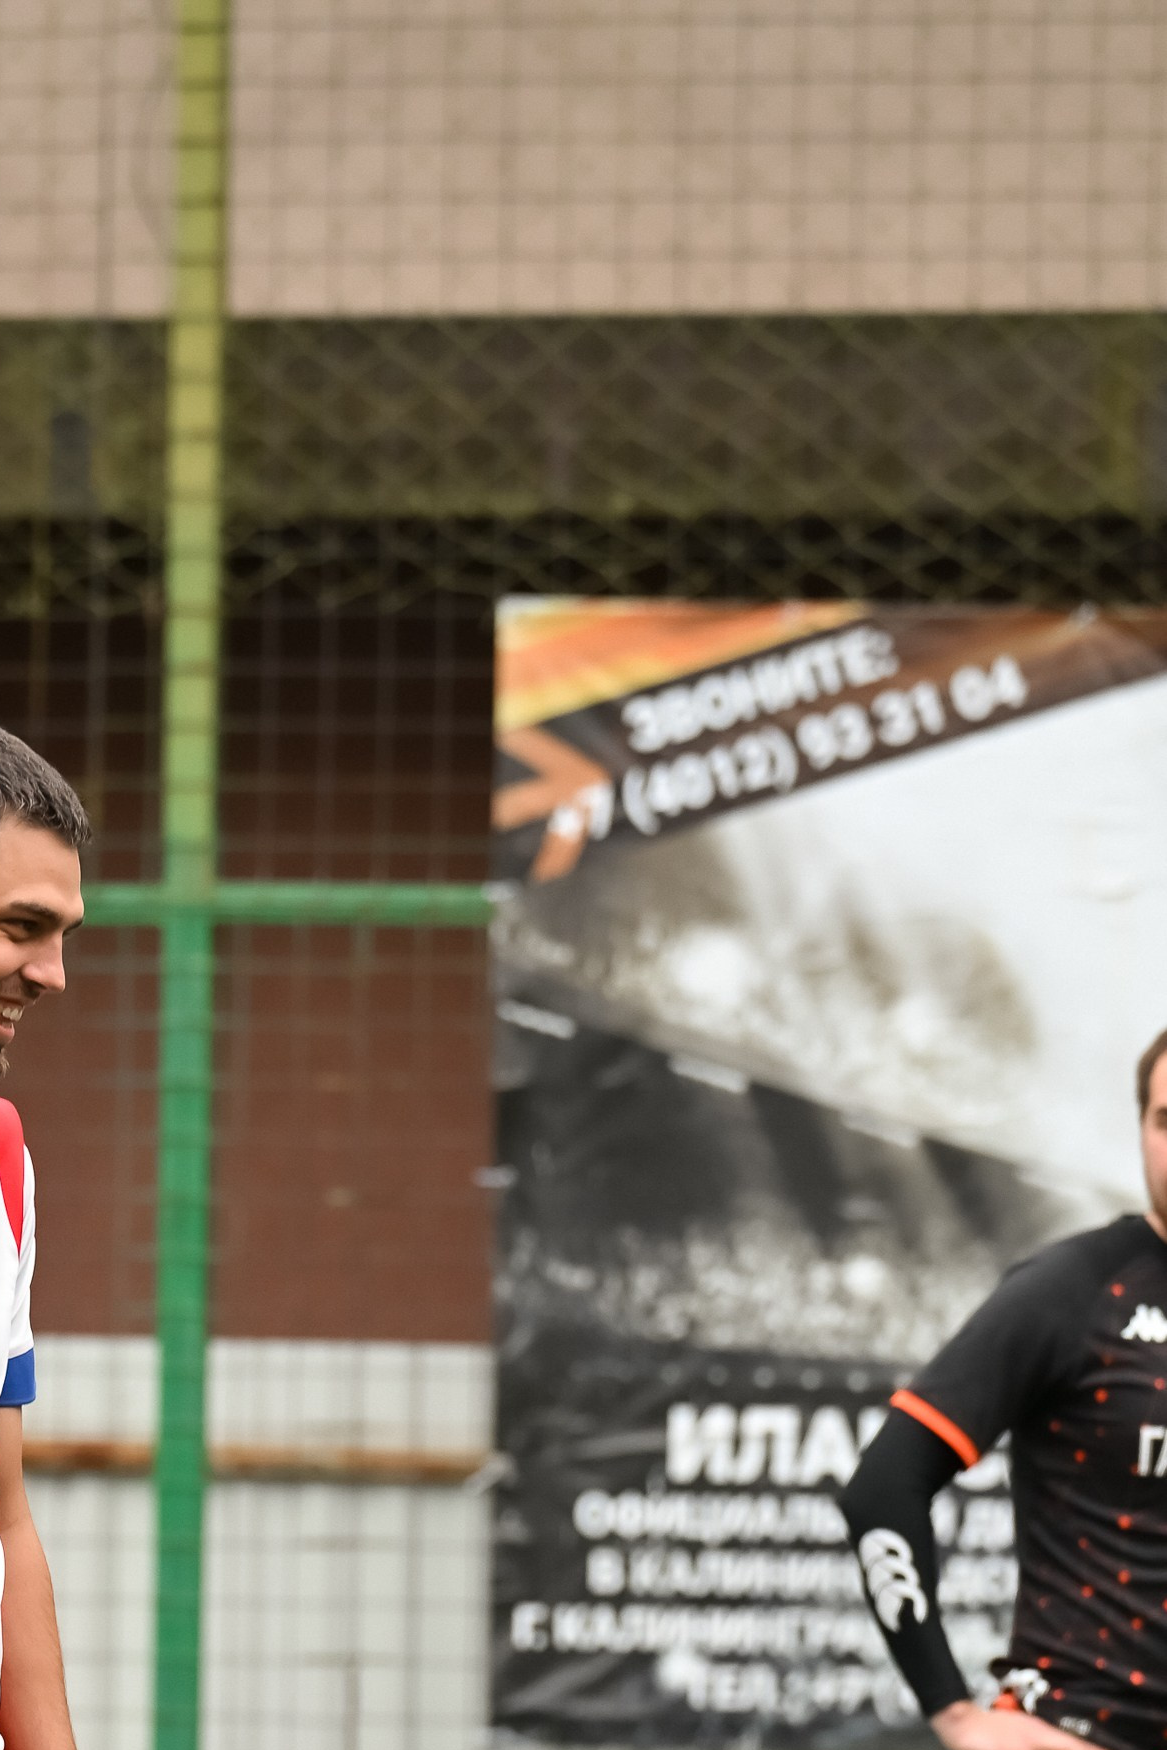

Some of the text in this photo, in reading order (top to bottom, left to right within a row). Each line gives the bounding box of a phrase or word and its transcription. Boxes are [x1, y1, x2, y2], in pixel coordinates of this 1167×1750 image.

[621, 625, 899, 753] ЗВОНИТЕ:
[622, 725, 798, 836] (4012)
[796, 703, 874, 770] 93
[872, 680, 946, 747] 31
[948, 655, 1029, 722] 04
